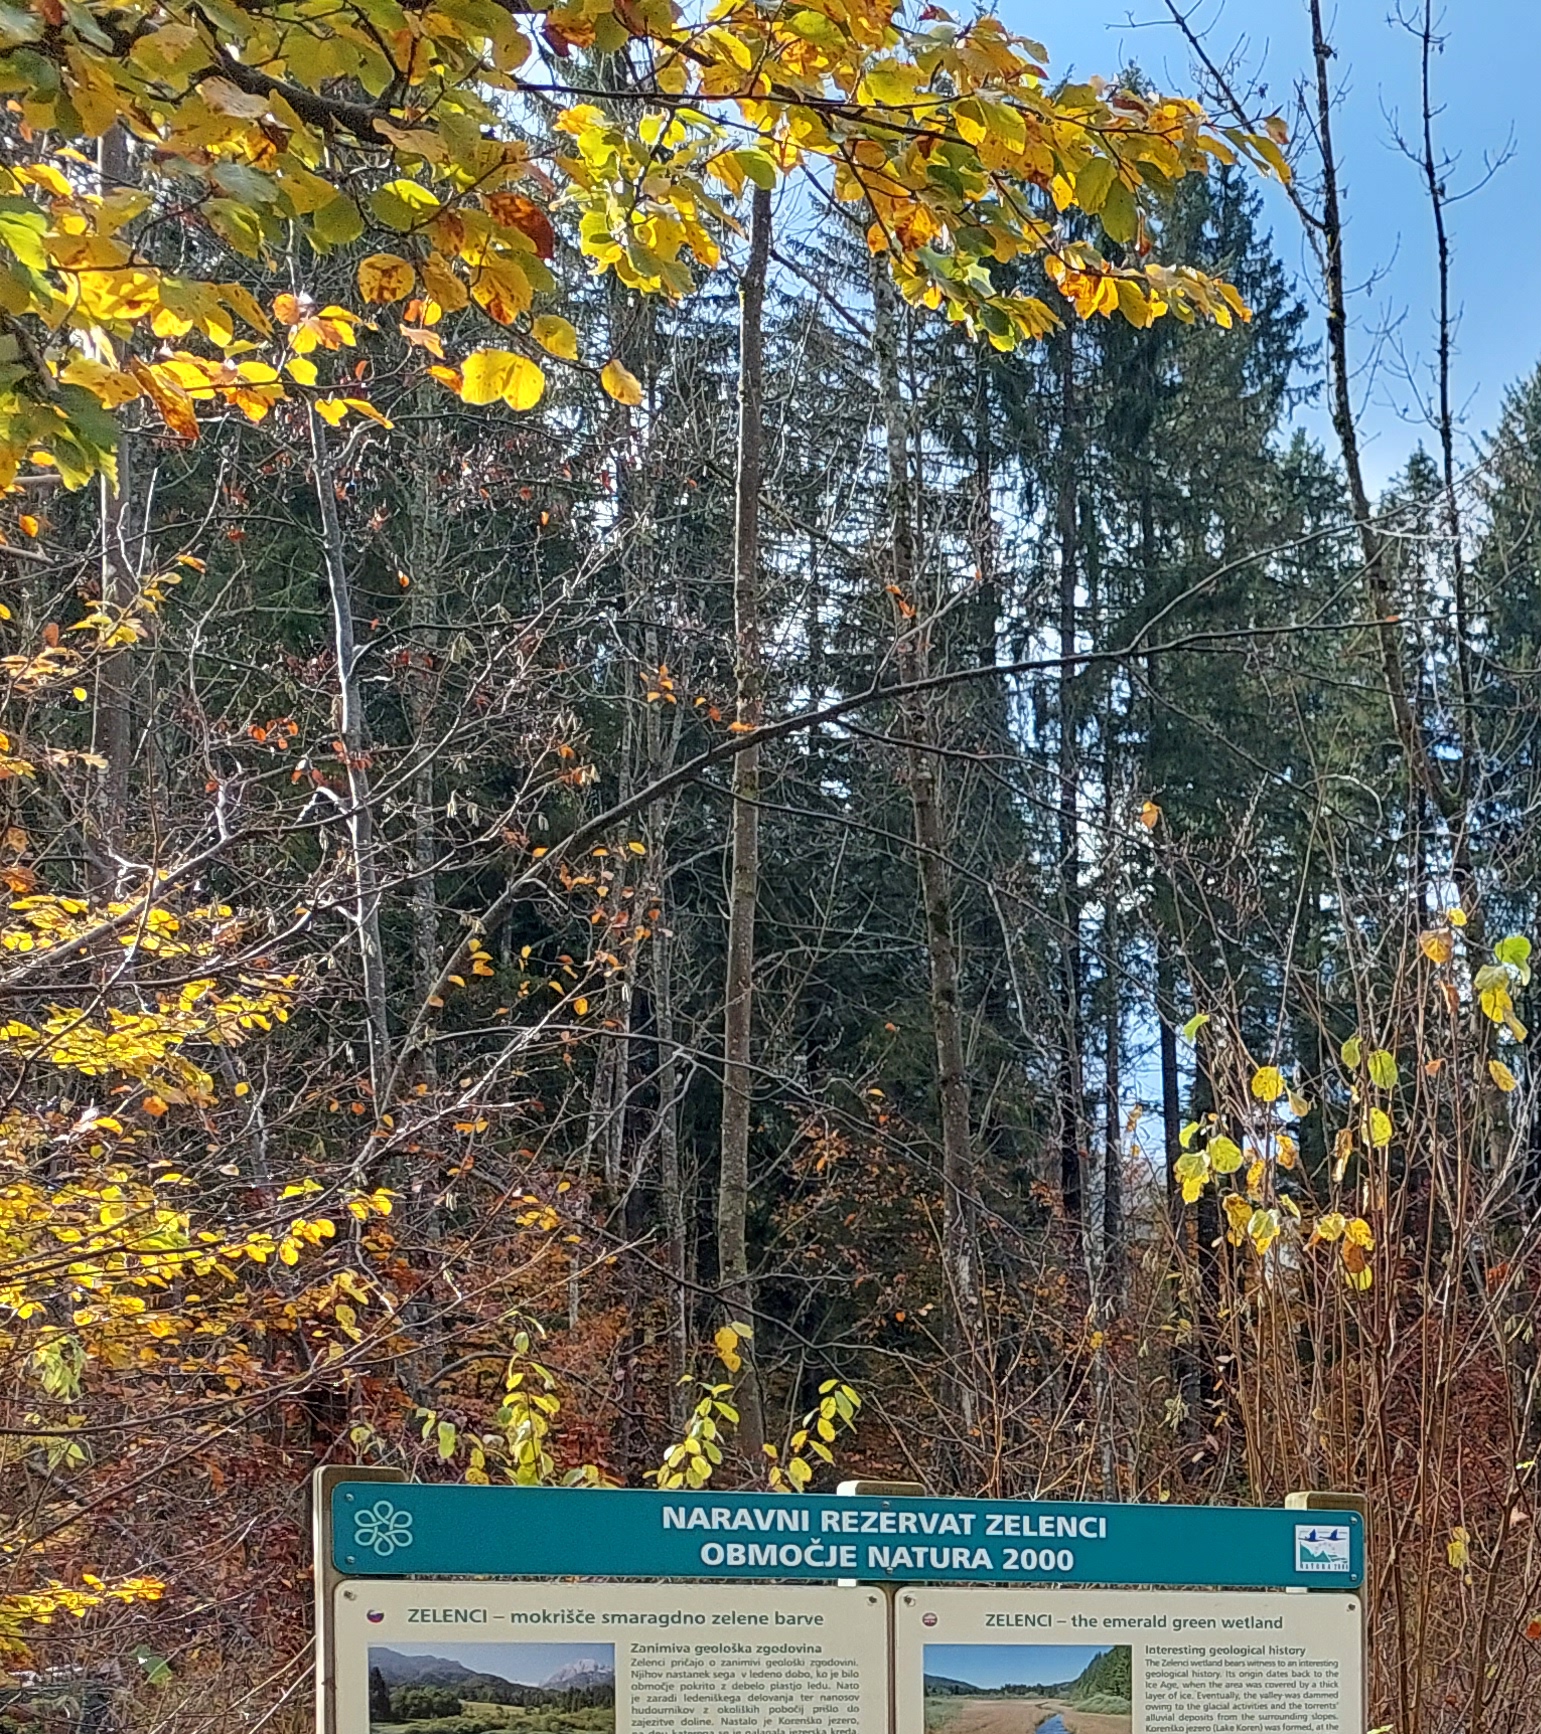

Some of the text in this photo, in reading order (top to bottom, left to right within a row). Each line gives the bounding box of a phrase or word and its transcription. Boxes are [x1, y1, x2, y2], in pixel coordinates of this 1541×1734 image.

[663, 1507, 1106, 1537] NARAVNI REZERVAT ZELENCI
[701, 1540, 1073, 1570] OBMOČJE NATURA 2000
[407, 1609, 486, 1623] ZELENCI
[511, 1609, 595, 1623] mokrišče
[601, 1611, 705, 1627] smaragdno
[712, 1611, 768, 1625] zelene
[775, 1611, 823, 1625] barve
[985, 1614, 1051, 1627] ZELENCI
[1071, 1614, 1097, 1627] the
[1103, 1615, 1166, 1627] emerald
[1172, 1619, 1216, 1631] green
[1221, 1616, 1282, 1629] wetland
[694, 1643, 751, 1656] geološka
[756, 1643, 821, 1655] zgodovina
[1145, 1645, 1305, 1657] Interesting geological history
